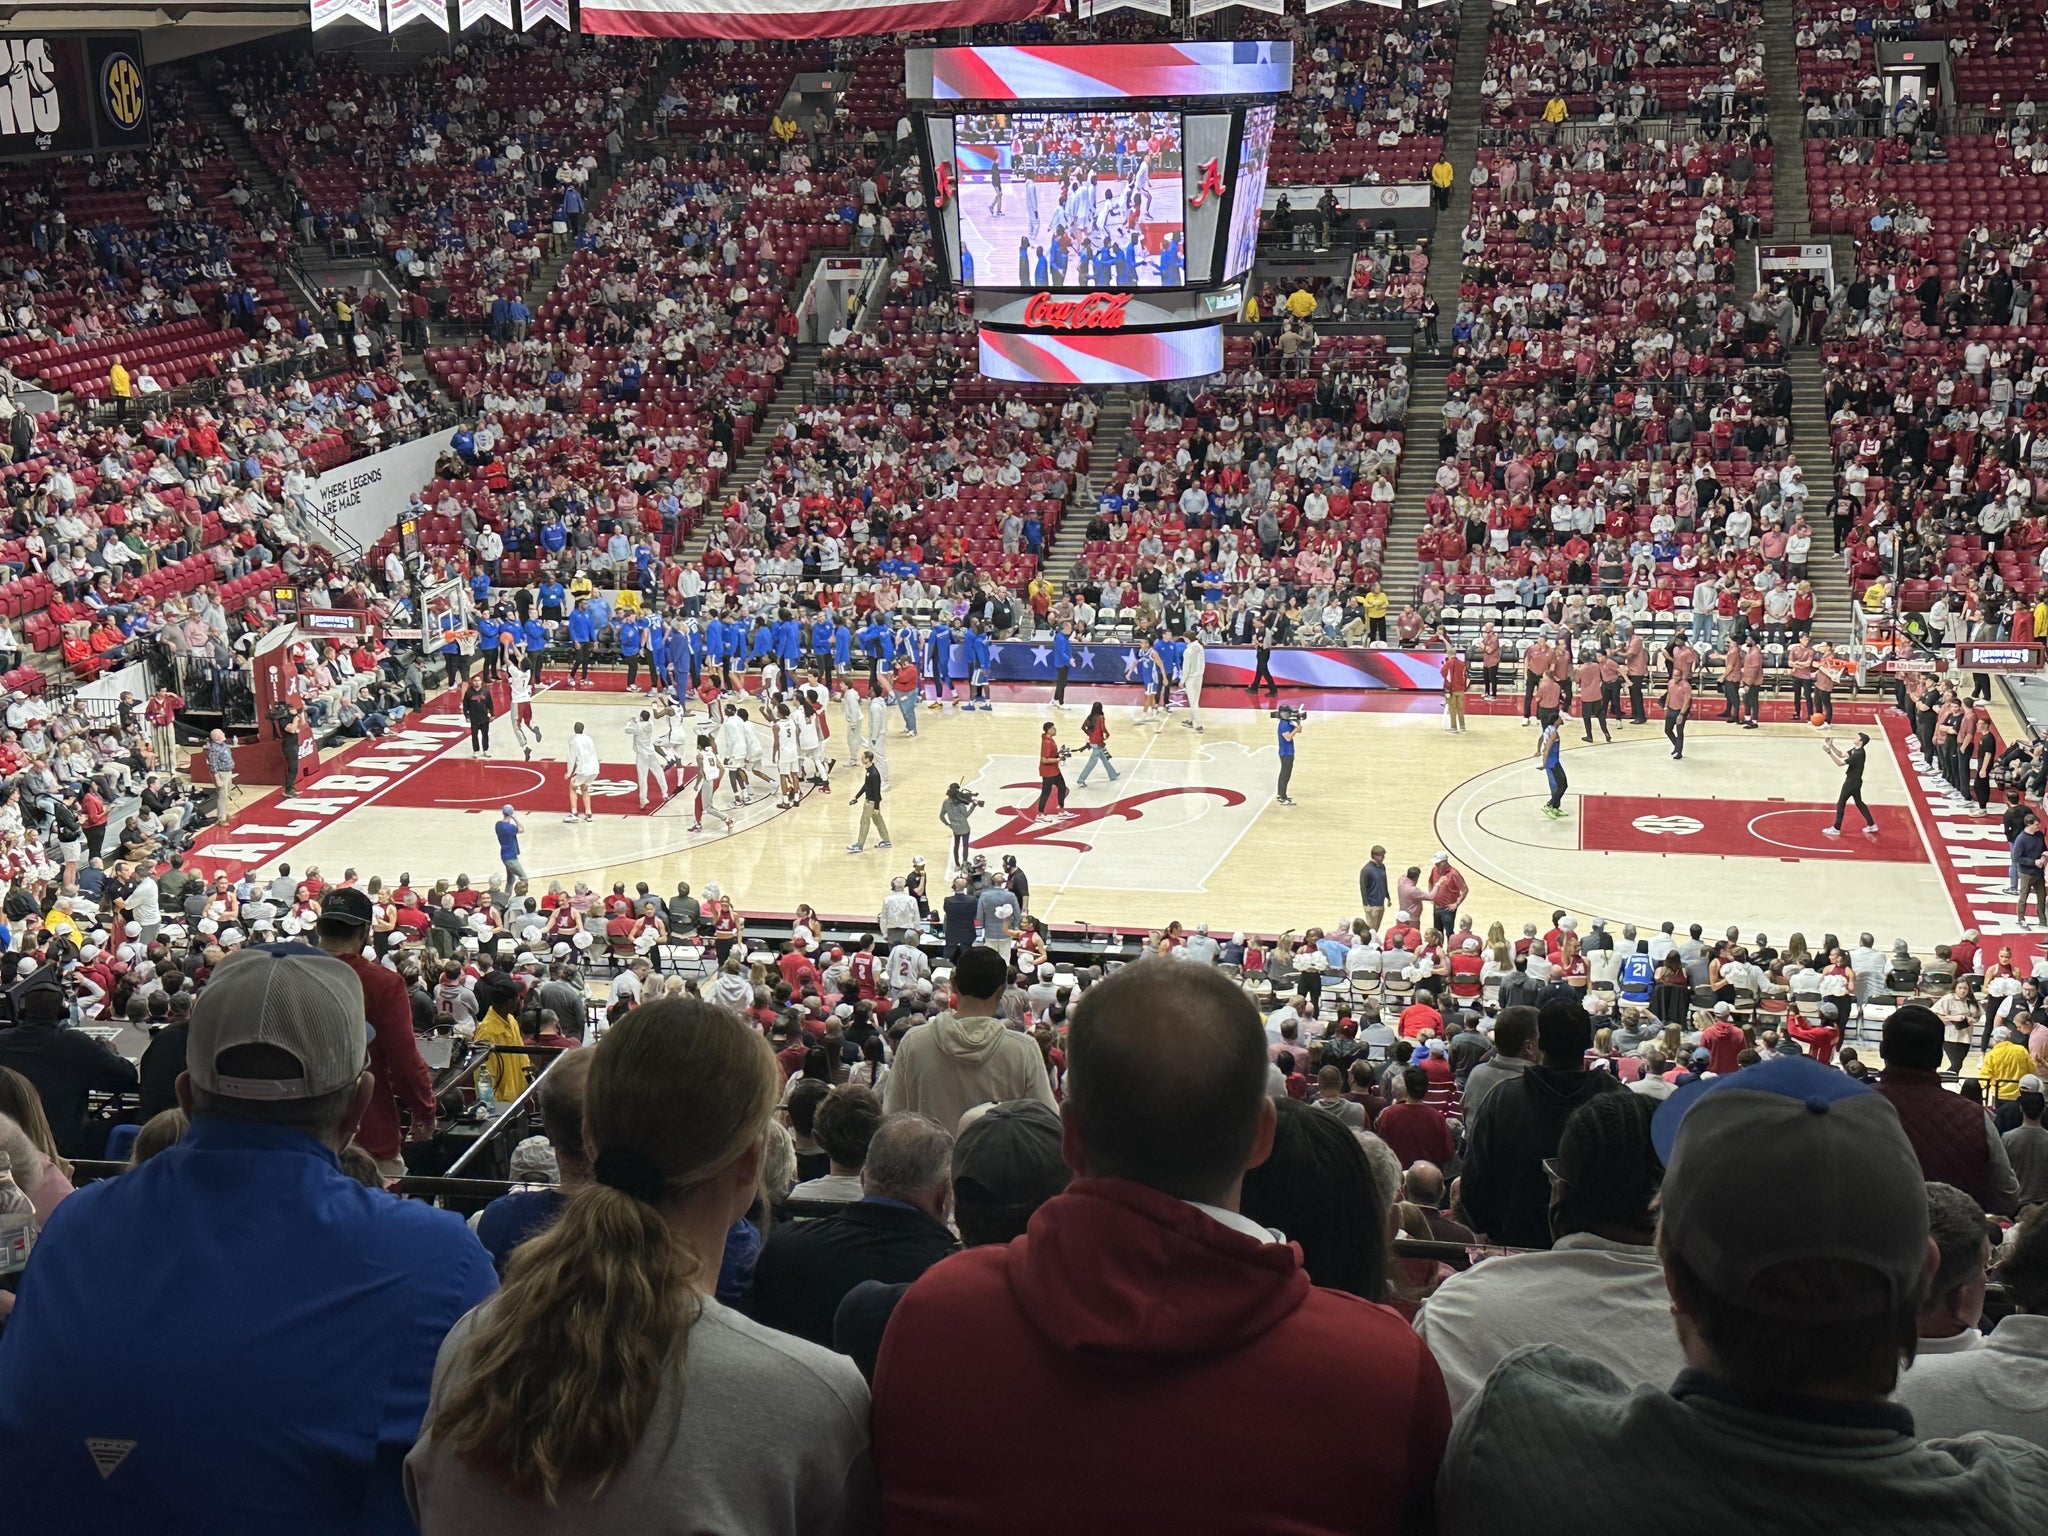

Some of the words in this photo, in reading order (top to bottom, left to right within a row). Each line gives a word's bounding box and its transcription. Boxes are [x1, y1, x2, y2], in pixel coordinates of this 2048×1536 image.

[109, 60, 141, 123] SEC
[1024, 292, 1133, 329] Coca-Cola
[320, 481, 347, 500] WHERE
[349, 468, 382, 490] LEGENDS
[323, 500, 338, 516] ARE
[339, 491, 361, 511] MADE
[194, 714, 471, 862] ALABAMA
[900, 962, 909, 976] 2
[1633, 963, 1647, 977] 21
